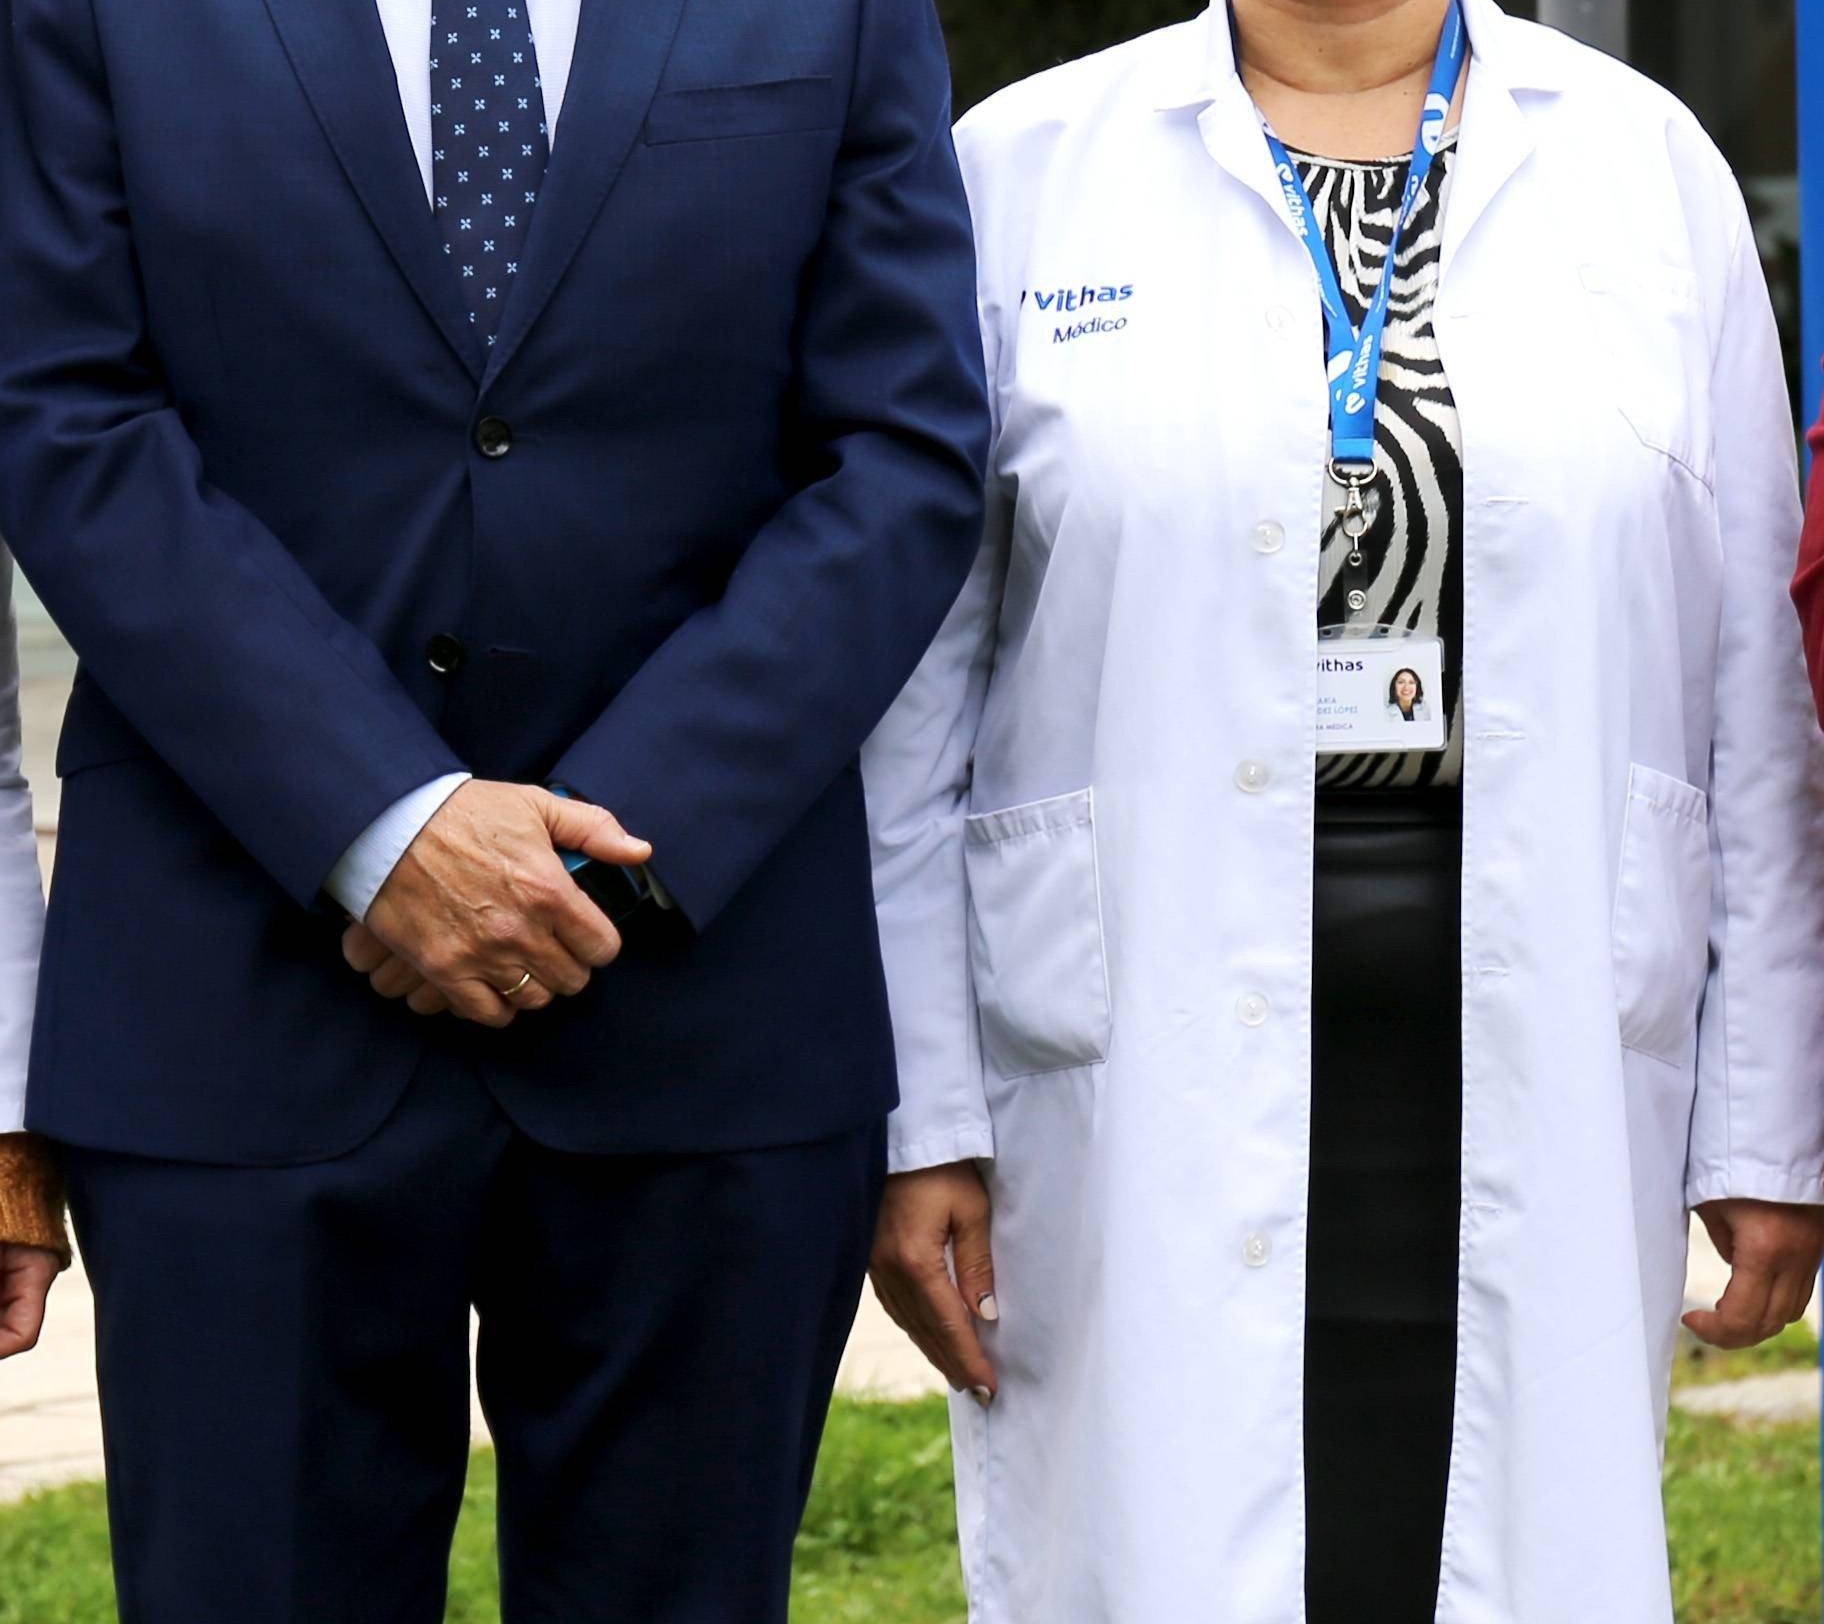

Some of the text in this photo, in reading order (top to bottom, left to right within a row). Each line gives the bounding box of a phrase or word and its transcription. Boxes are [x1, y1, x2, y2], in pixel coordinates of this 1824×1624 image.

[1283, 183, 1309, 238] vithas
[1033, 284, 1135, 313] vithas
[1052, 316, 1129, 345] Médico
[1352, 334, 1374, 390] vithas
